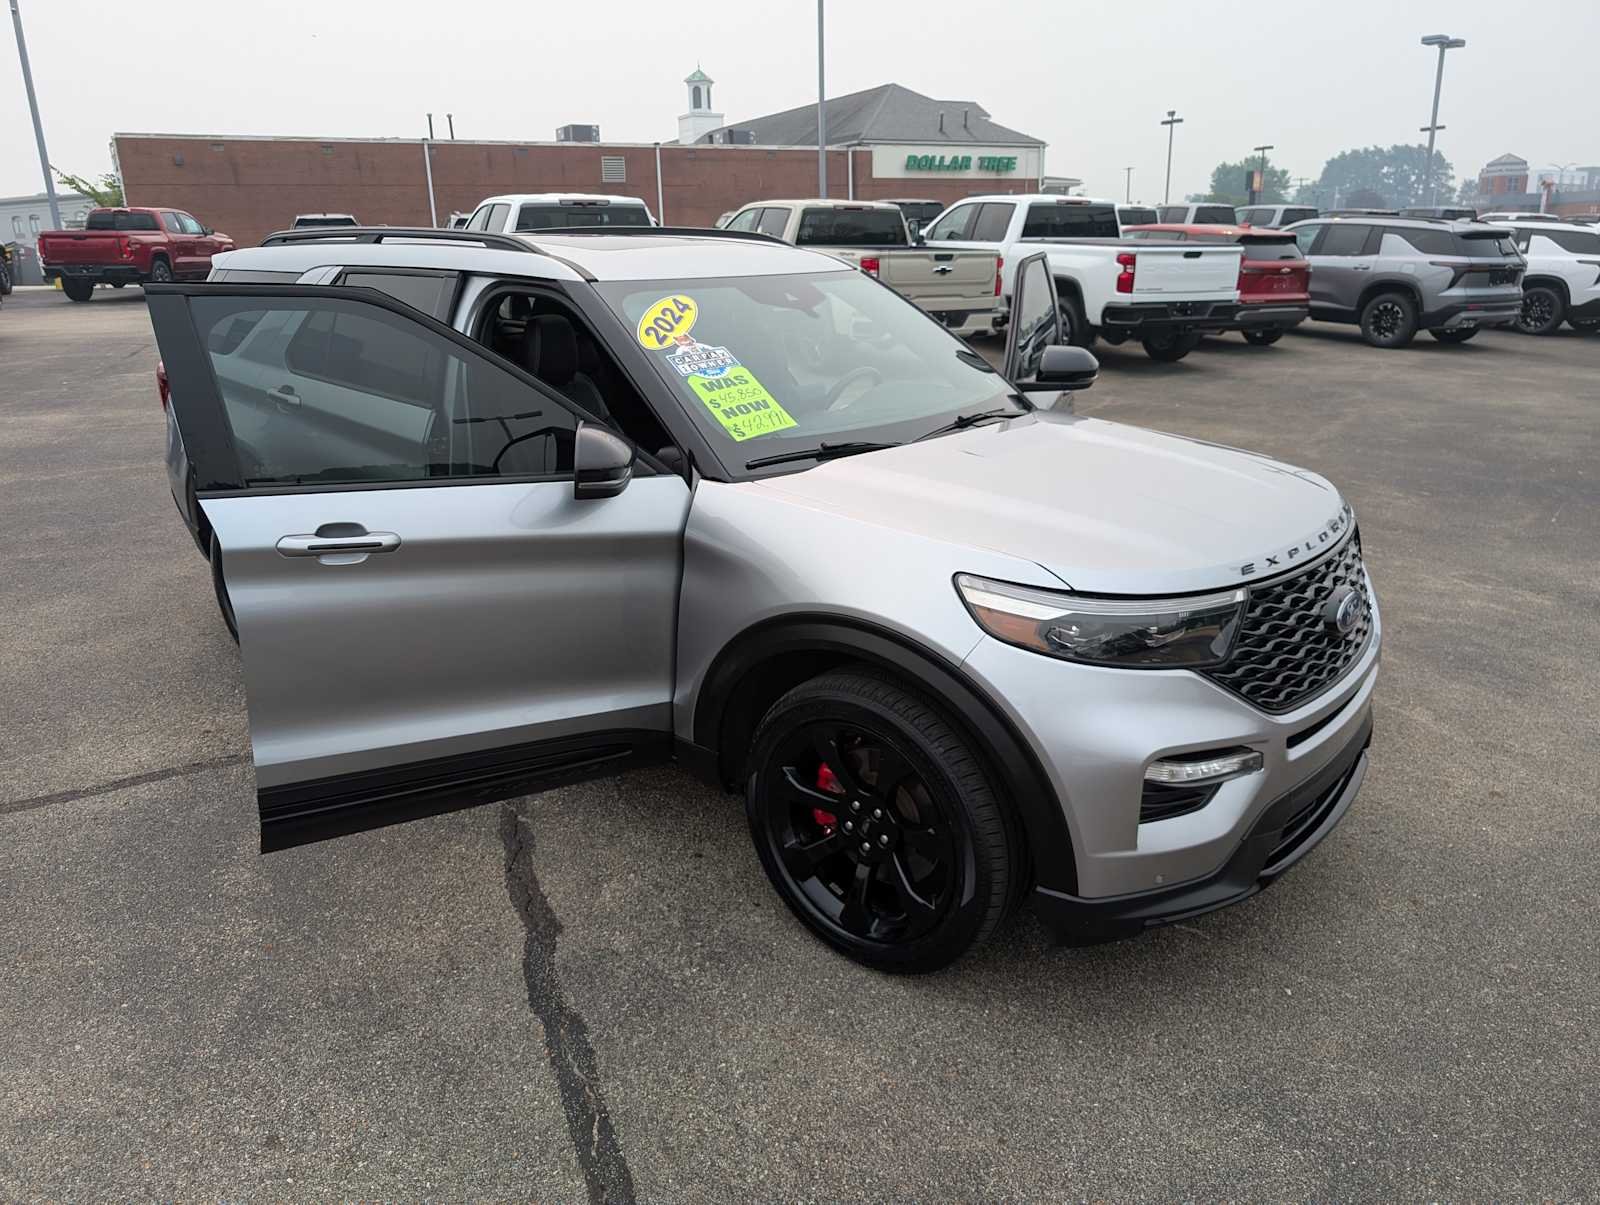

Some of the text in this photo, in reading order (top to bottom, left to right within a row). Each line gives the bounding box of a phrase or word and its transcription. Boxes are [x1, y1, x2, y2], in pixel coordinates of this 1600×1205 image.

[905, 154, 1018, 171] DOLLAR TREE
[644, 297, 693, 346] 2024
[700, 375, 749, 392] WAS
[721, 399, 771, 419] NOW
